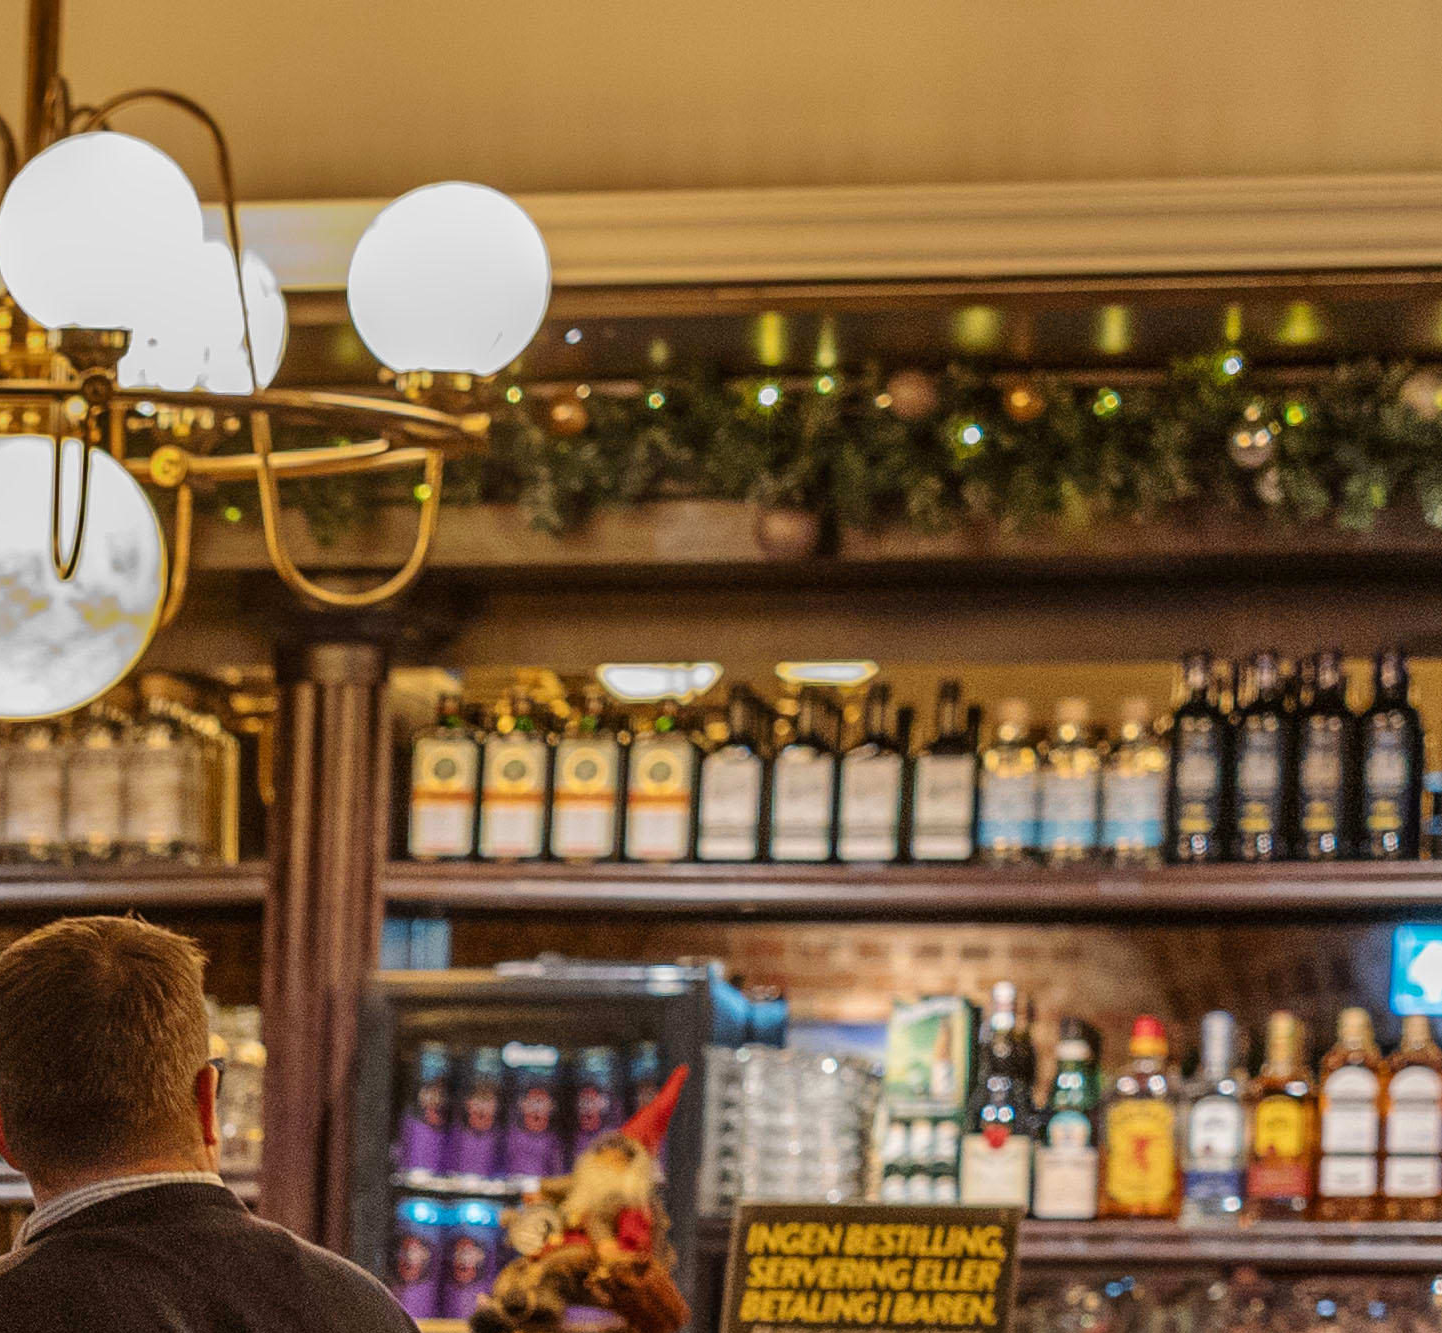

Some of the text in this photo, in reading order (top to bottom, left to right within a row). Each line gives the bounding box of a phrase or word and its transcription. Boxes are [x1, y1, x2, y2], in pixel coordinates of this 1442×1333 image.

[746, 1222, 844, 1255] INGEN
[746, 1257, 1001, 1291] SERVERING ELLER
[739, 1289, 877, 1324] BETALING
[877, 1291, 892, 1323] I
